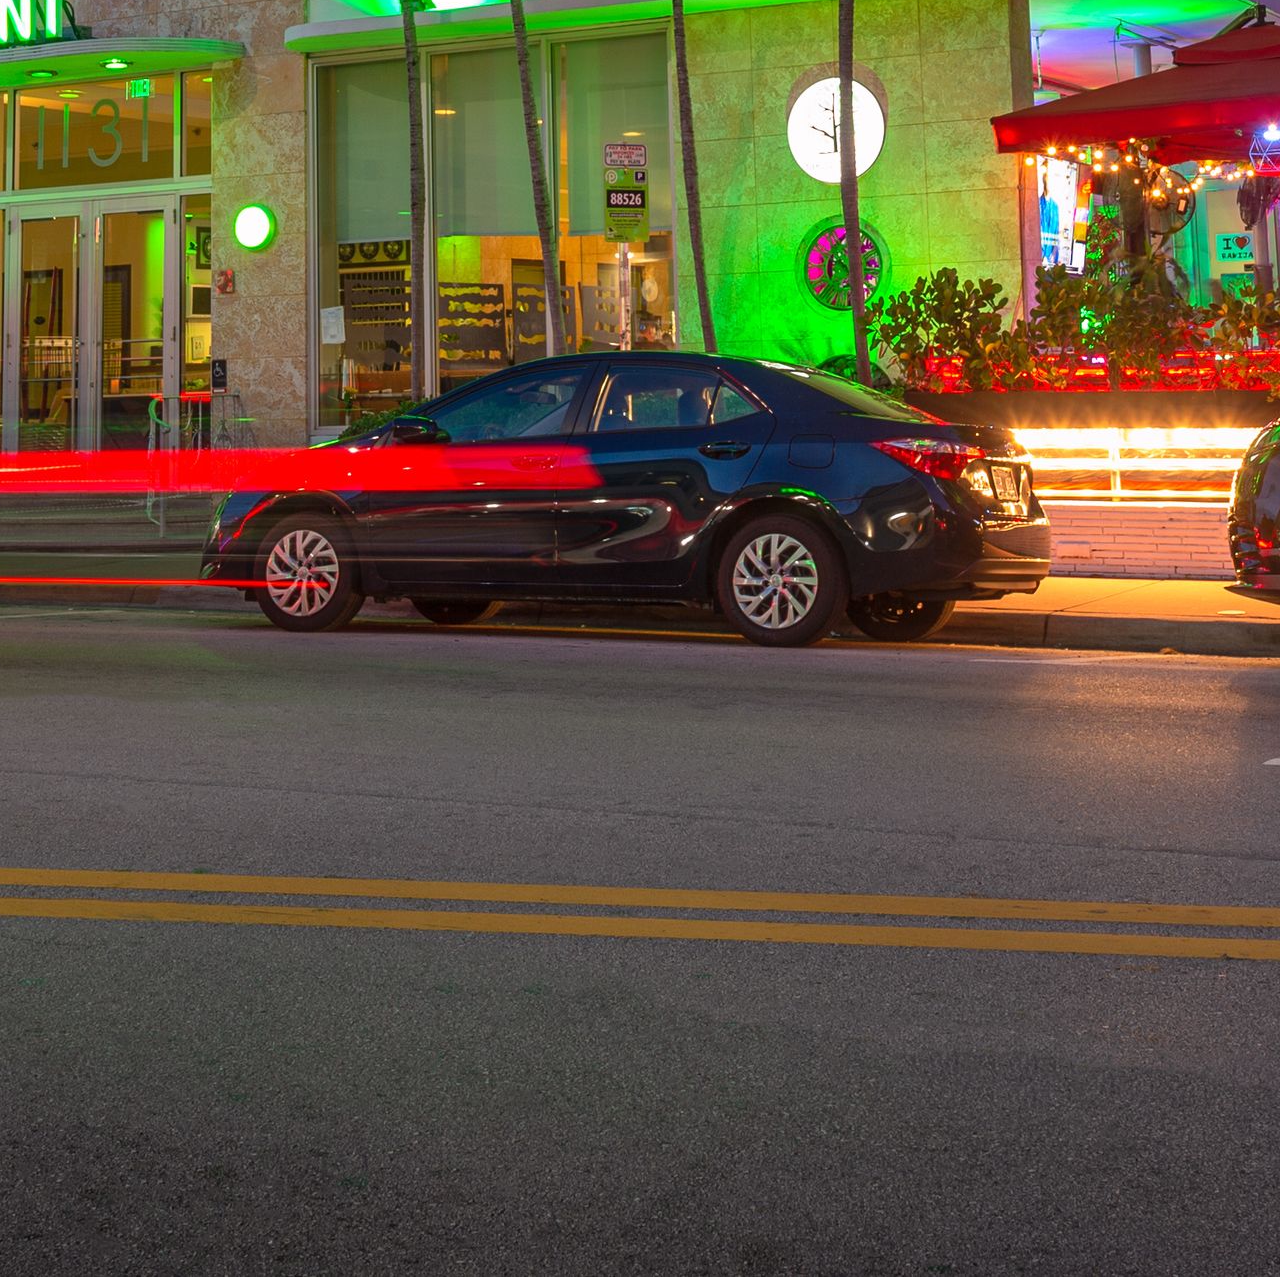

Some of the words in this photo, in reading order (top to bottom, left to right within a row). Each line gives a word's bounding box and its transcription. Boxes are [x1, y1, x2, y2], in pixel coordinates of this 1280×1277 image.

[37, 96, 149, 170] 1131
[610, 193, 642, 205] 88526
[1222, 238, 1232, 250] I
